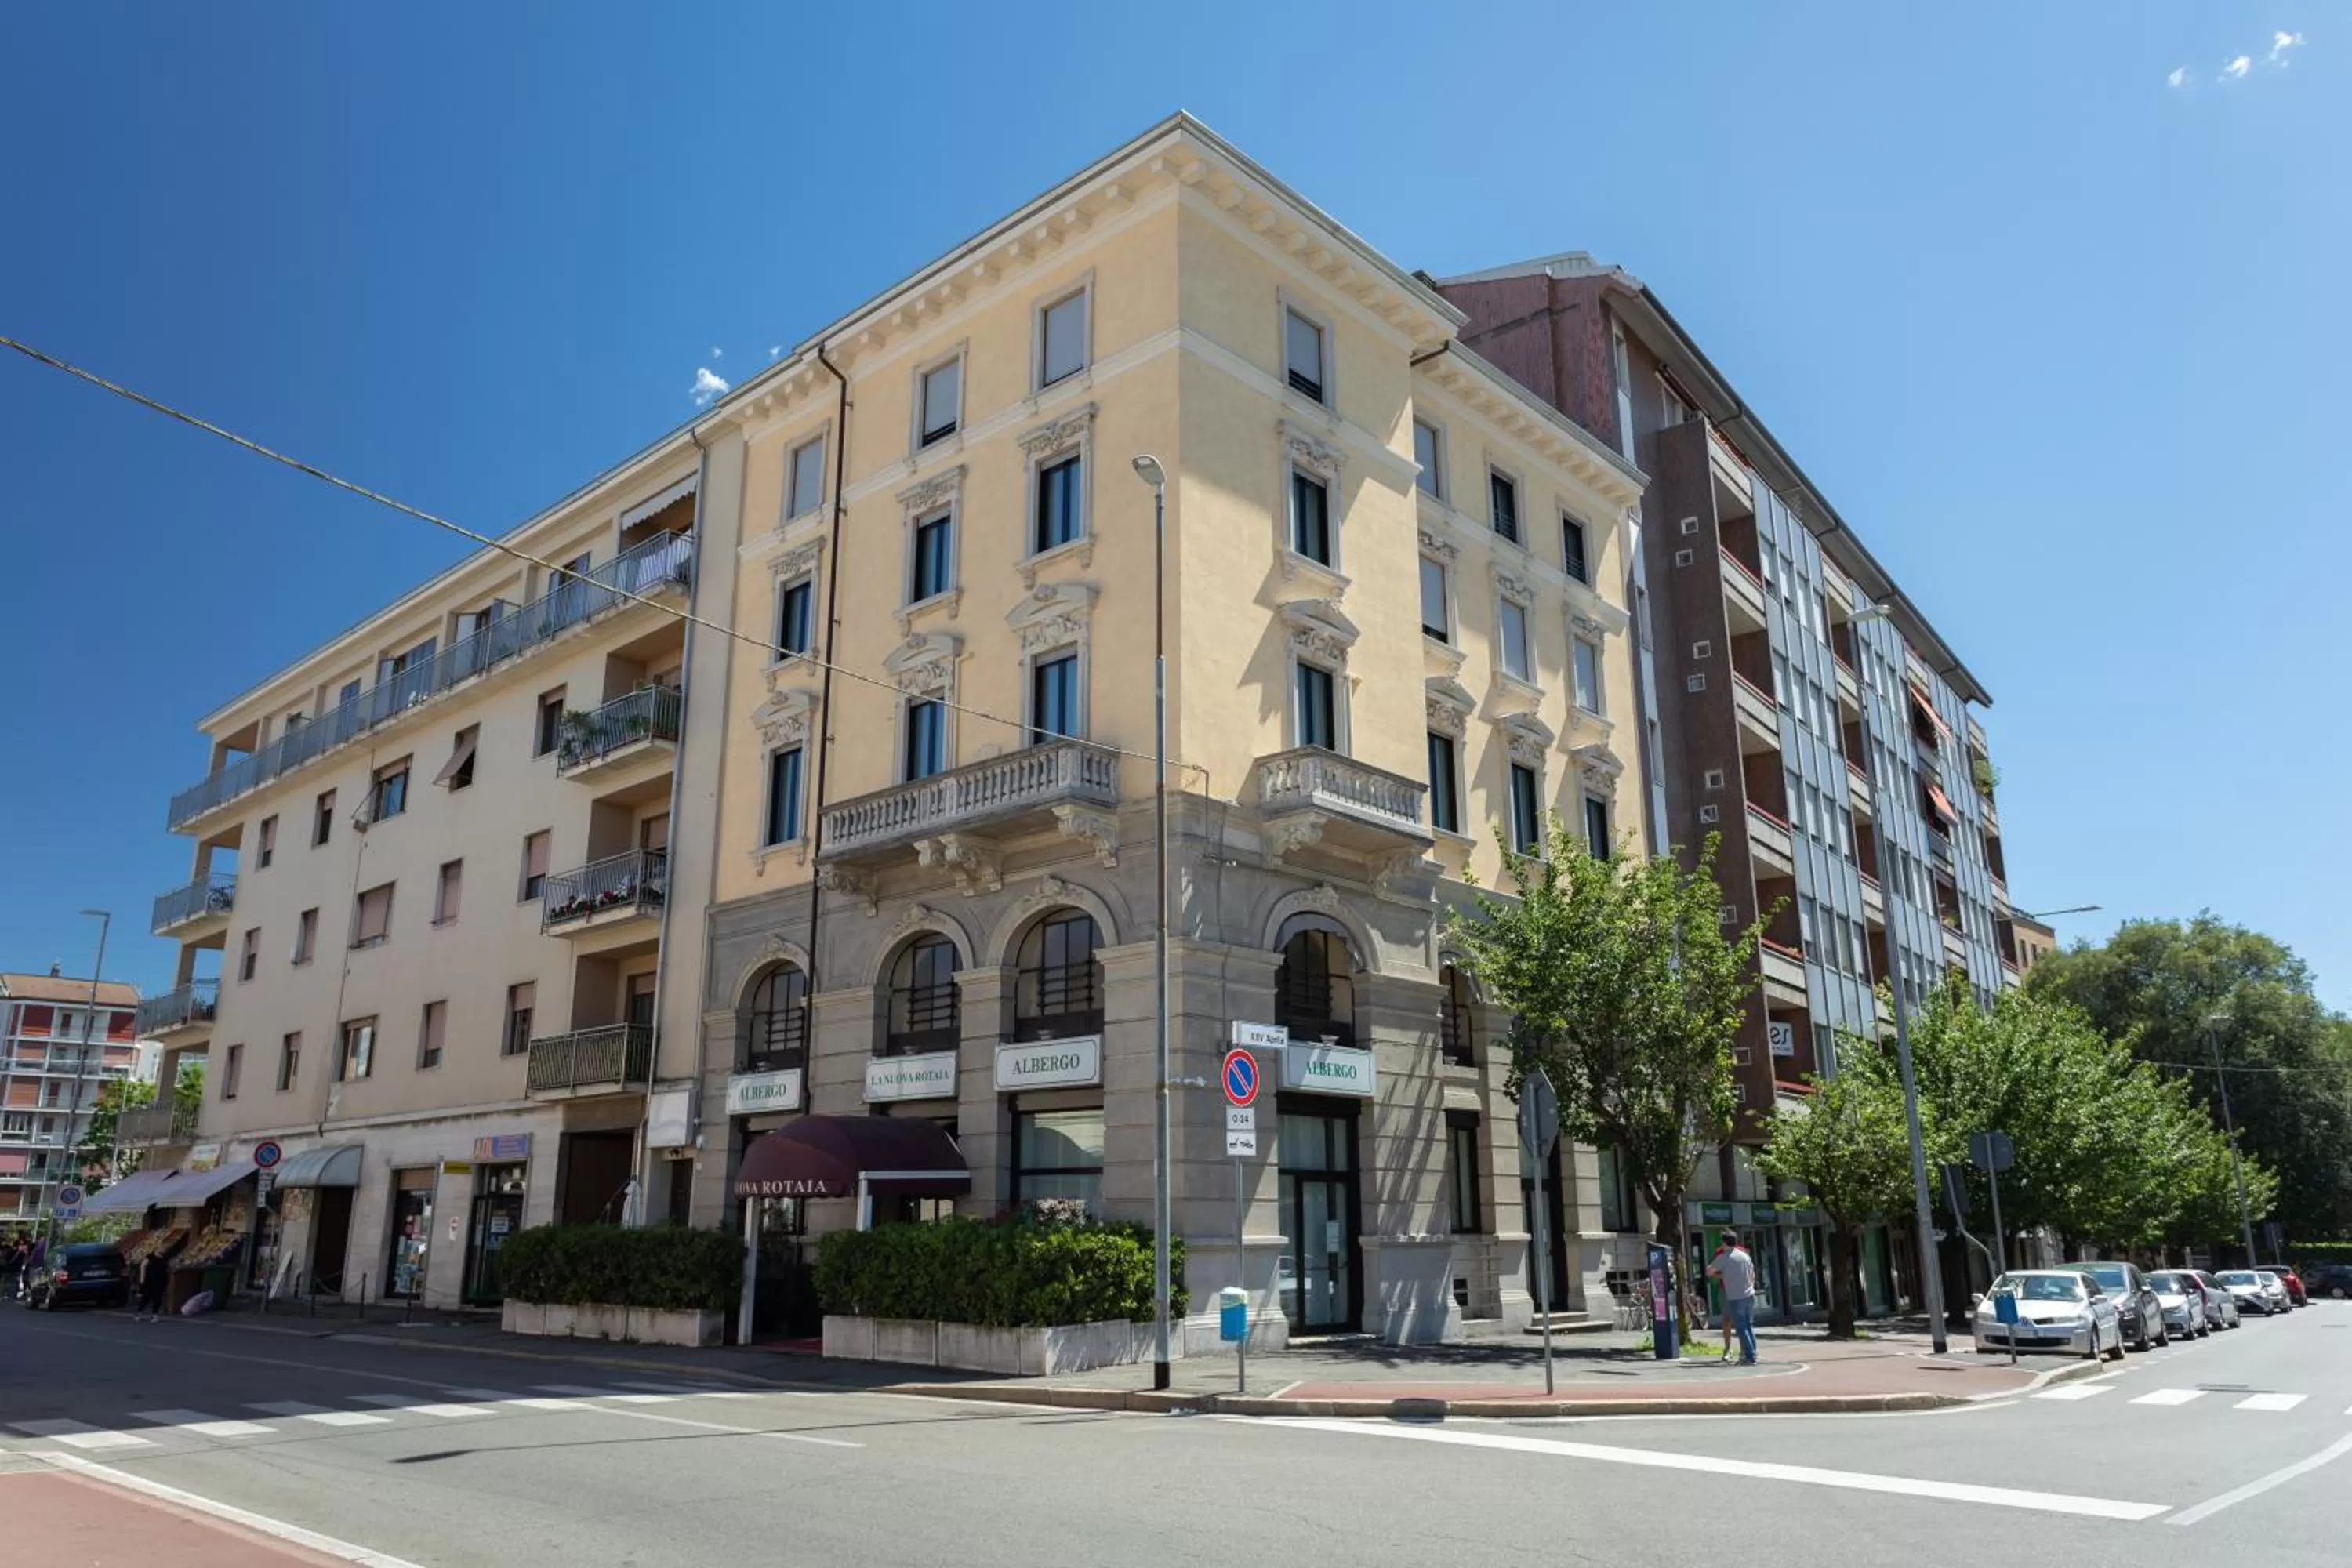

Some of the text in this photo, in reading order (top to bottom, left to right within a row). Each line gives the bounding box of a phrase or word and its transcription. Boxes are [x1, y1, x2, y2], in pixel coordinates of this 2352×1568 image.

[1012, 1053, 1080, 1075] ALBERGO
[1305, 1061, 1357, 1080] ALBERGO
[869, 1069, 950, 1086] LA NUOVA ROTAIA
[739, 1083, 787, 1102] ALBERGO
[761, 1178, 829, 1194] ROTAIA
